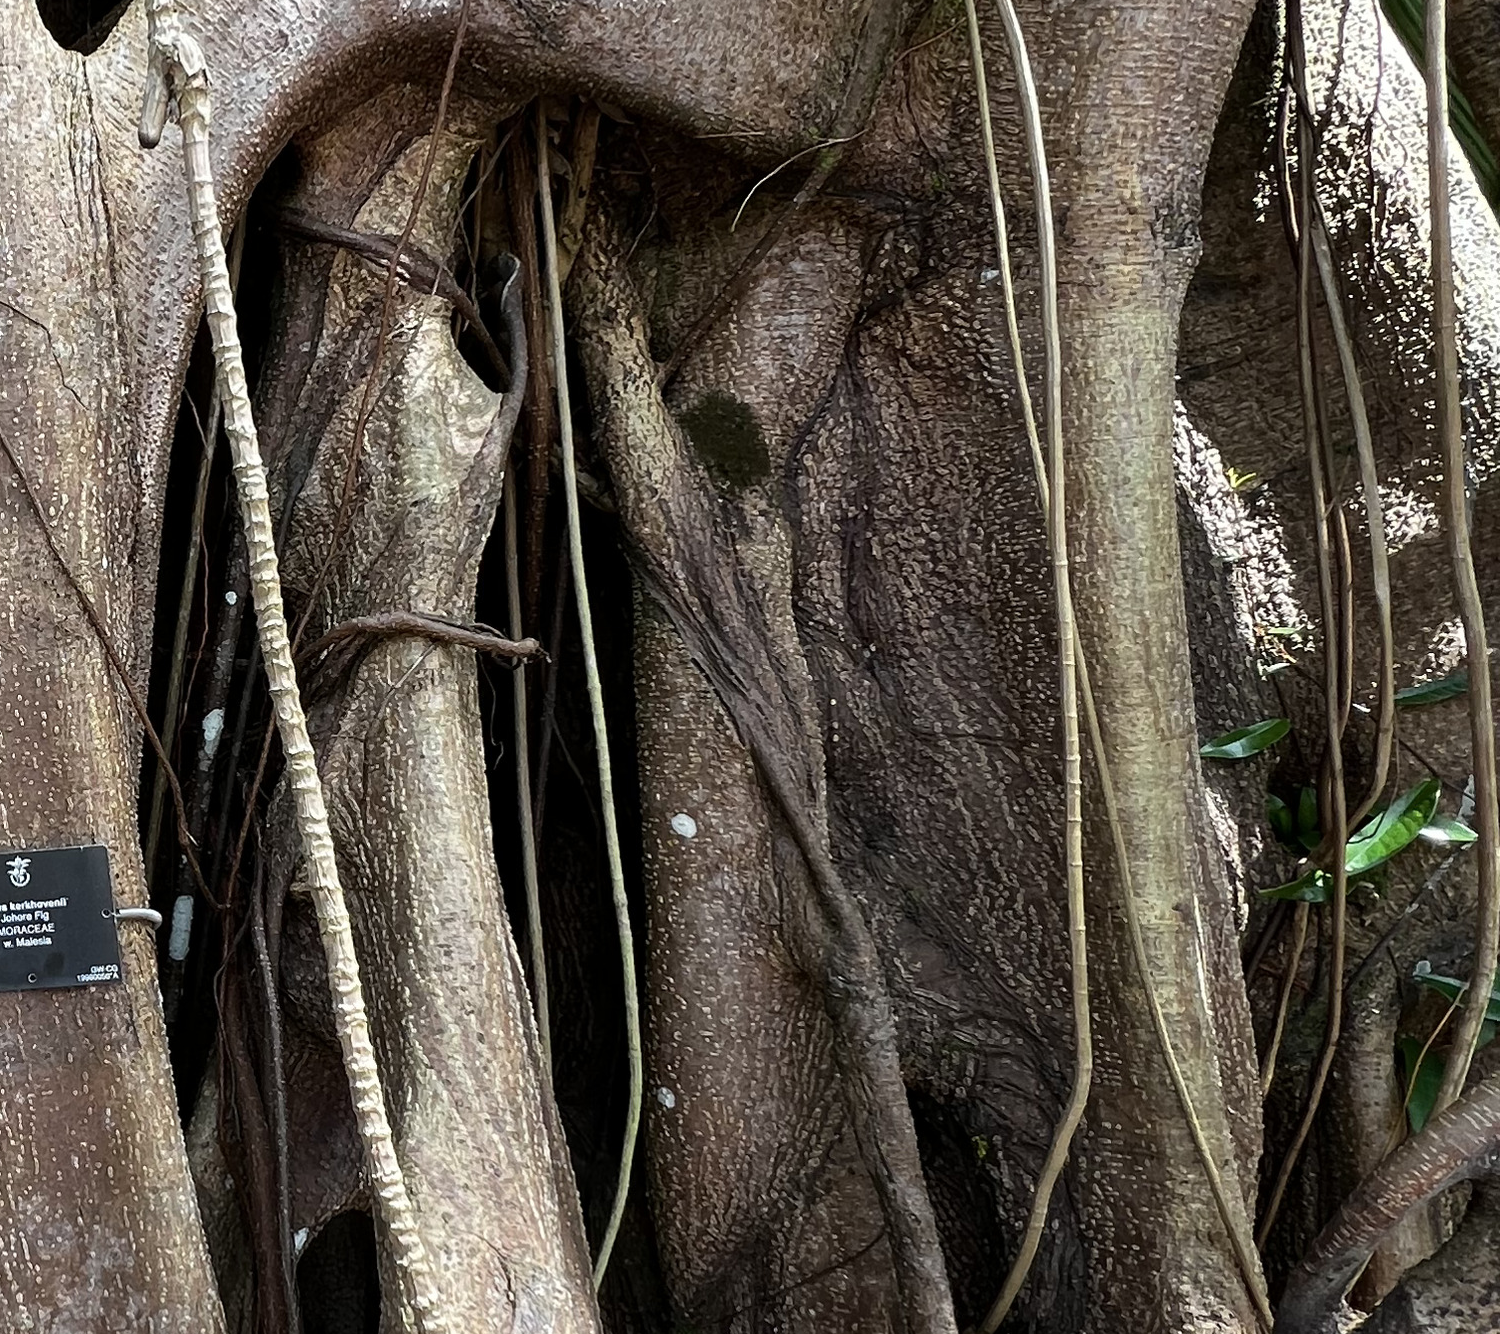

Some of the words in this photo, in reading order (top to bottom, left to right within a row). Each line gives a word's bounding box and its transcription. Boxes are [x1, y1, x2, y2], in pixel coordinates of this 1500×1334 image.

[0, 913, 32, 923] Johore
[34, 910, 49, 921] Fig
[16, 935, 52, 947] Malesia
